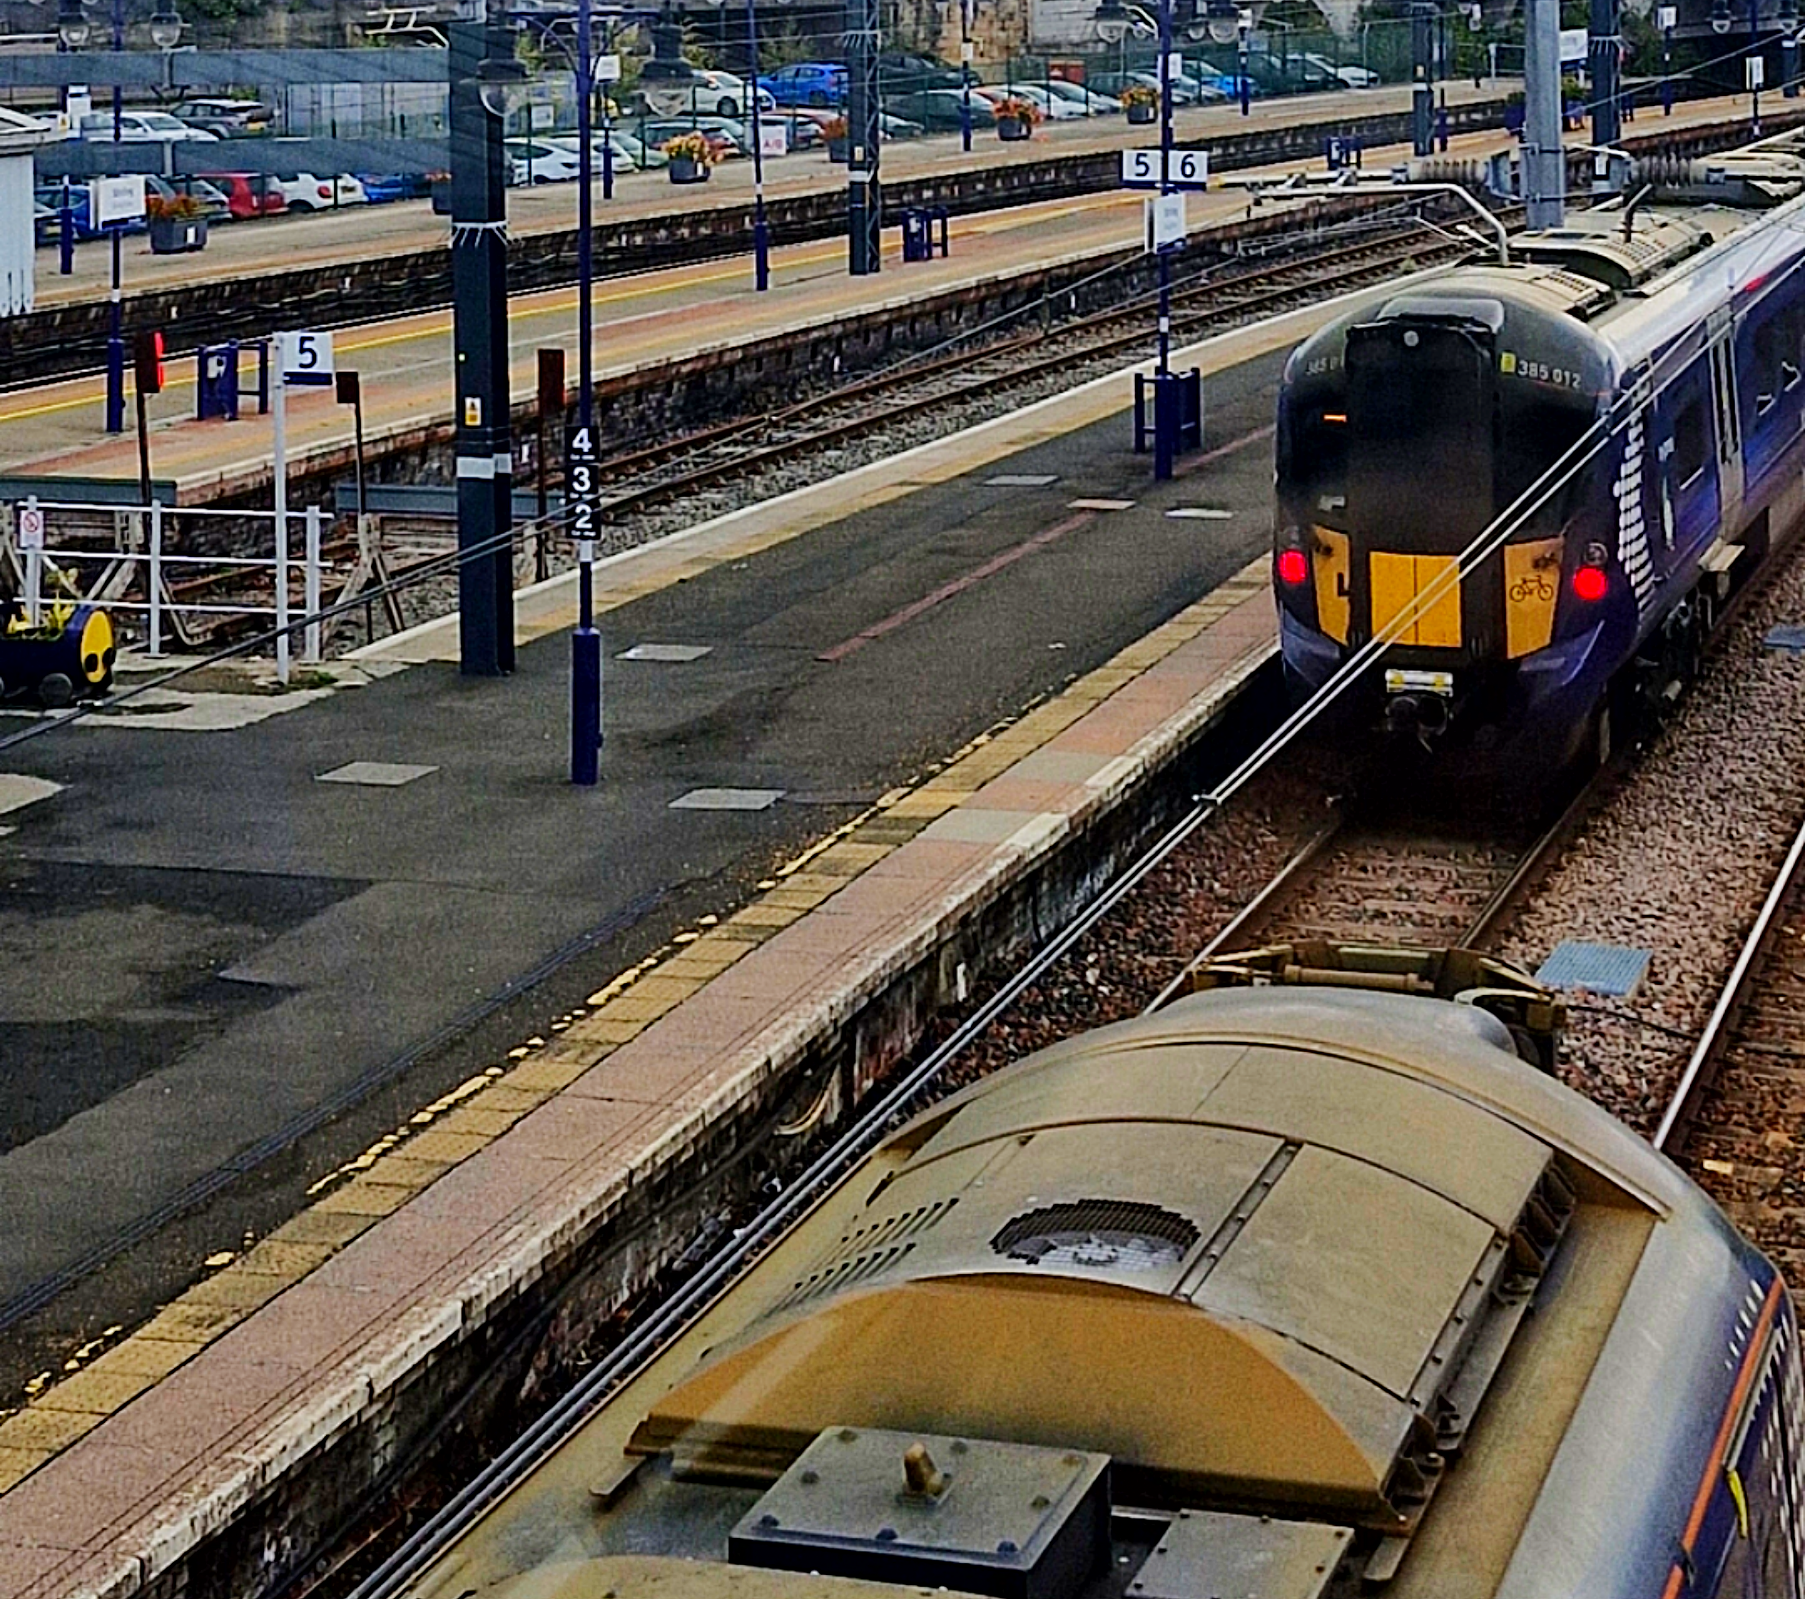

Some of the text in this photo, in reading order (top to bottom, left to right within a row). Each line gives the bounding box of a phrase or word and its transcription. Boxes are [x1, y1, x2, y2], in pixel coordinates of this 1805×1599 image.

[1134, 152, 1150, 177] 5
[1181, 153, 1196, 179] 6
[298, 336, 318, 369] 5
[1518, 359, 1582, 389] 385 012
[572, 427, 593, 453] 4
[572, 466, 592, 492] 3
[575, 503, 593, 529] 2
